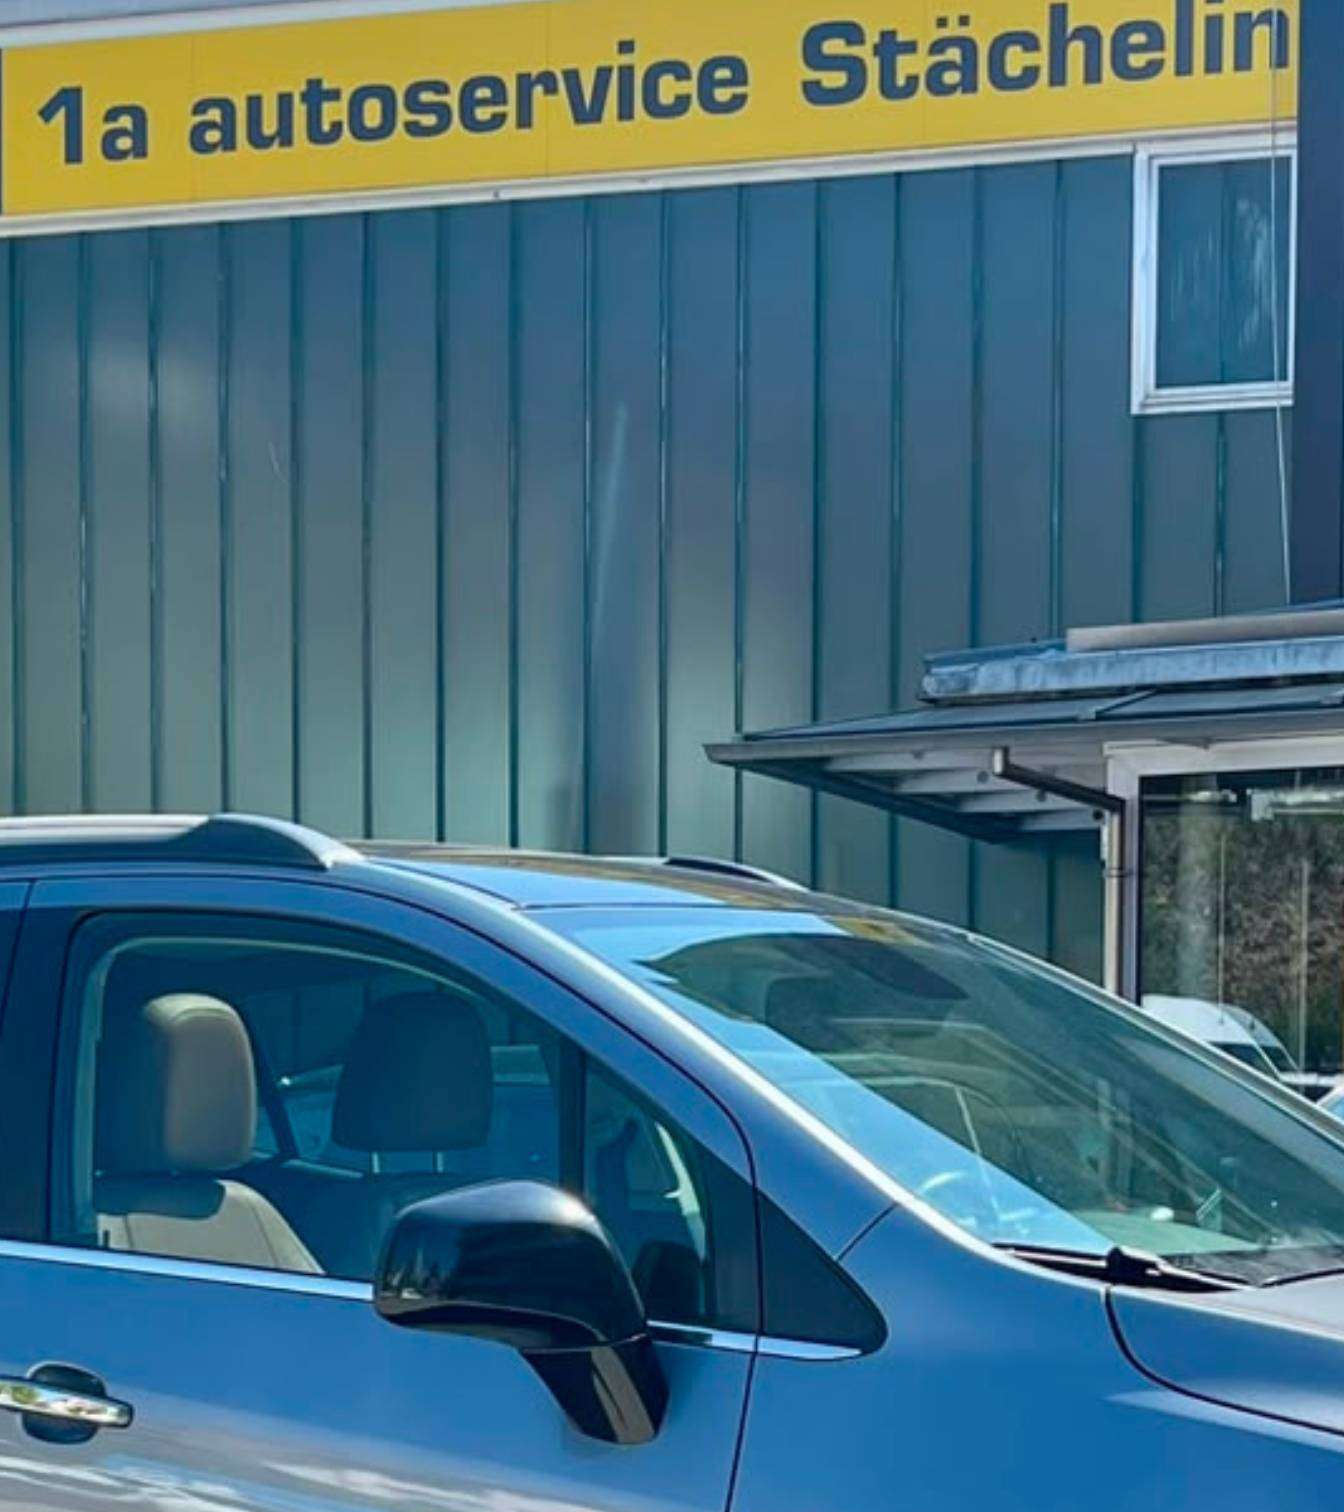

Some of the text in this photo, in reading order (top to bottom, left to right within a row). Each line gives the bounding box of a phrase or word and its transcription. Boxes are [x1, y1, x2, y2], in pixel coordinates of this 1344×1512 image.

[36, 0, 1290, 165] 1a autoservice Stächelin
